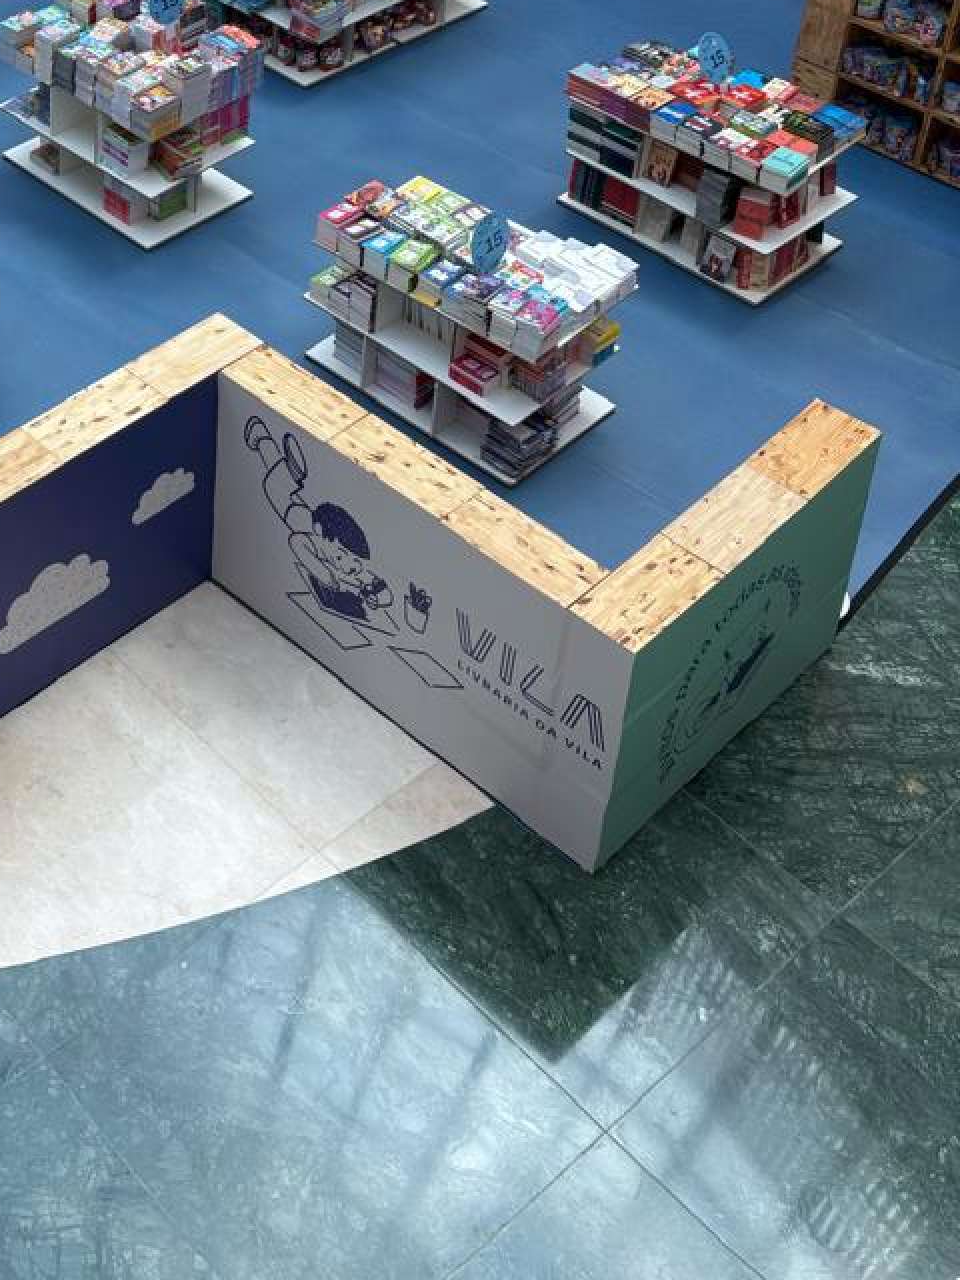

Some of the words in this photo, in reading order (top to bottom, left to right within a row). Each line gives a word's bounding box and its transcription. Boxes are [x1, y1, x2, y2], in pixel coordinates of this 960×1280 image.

[710, 49, 726, 69] 15
[486, 230, 503, 254] 15
[455, 607, 605, 753] VILA
[535, 718, 557, 740] DA
[565, 736, 602, 772] VILA
